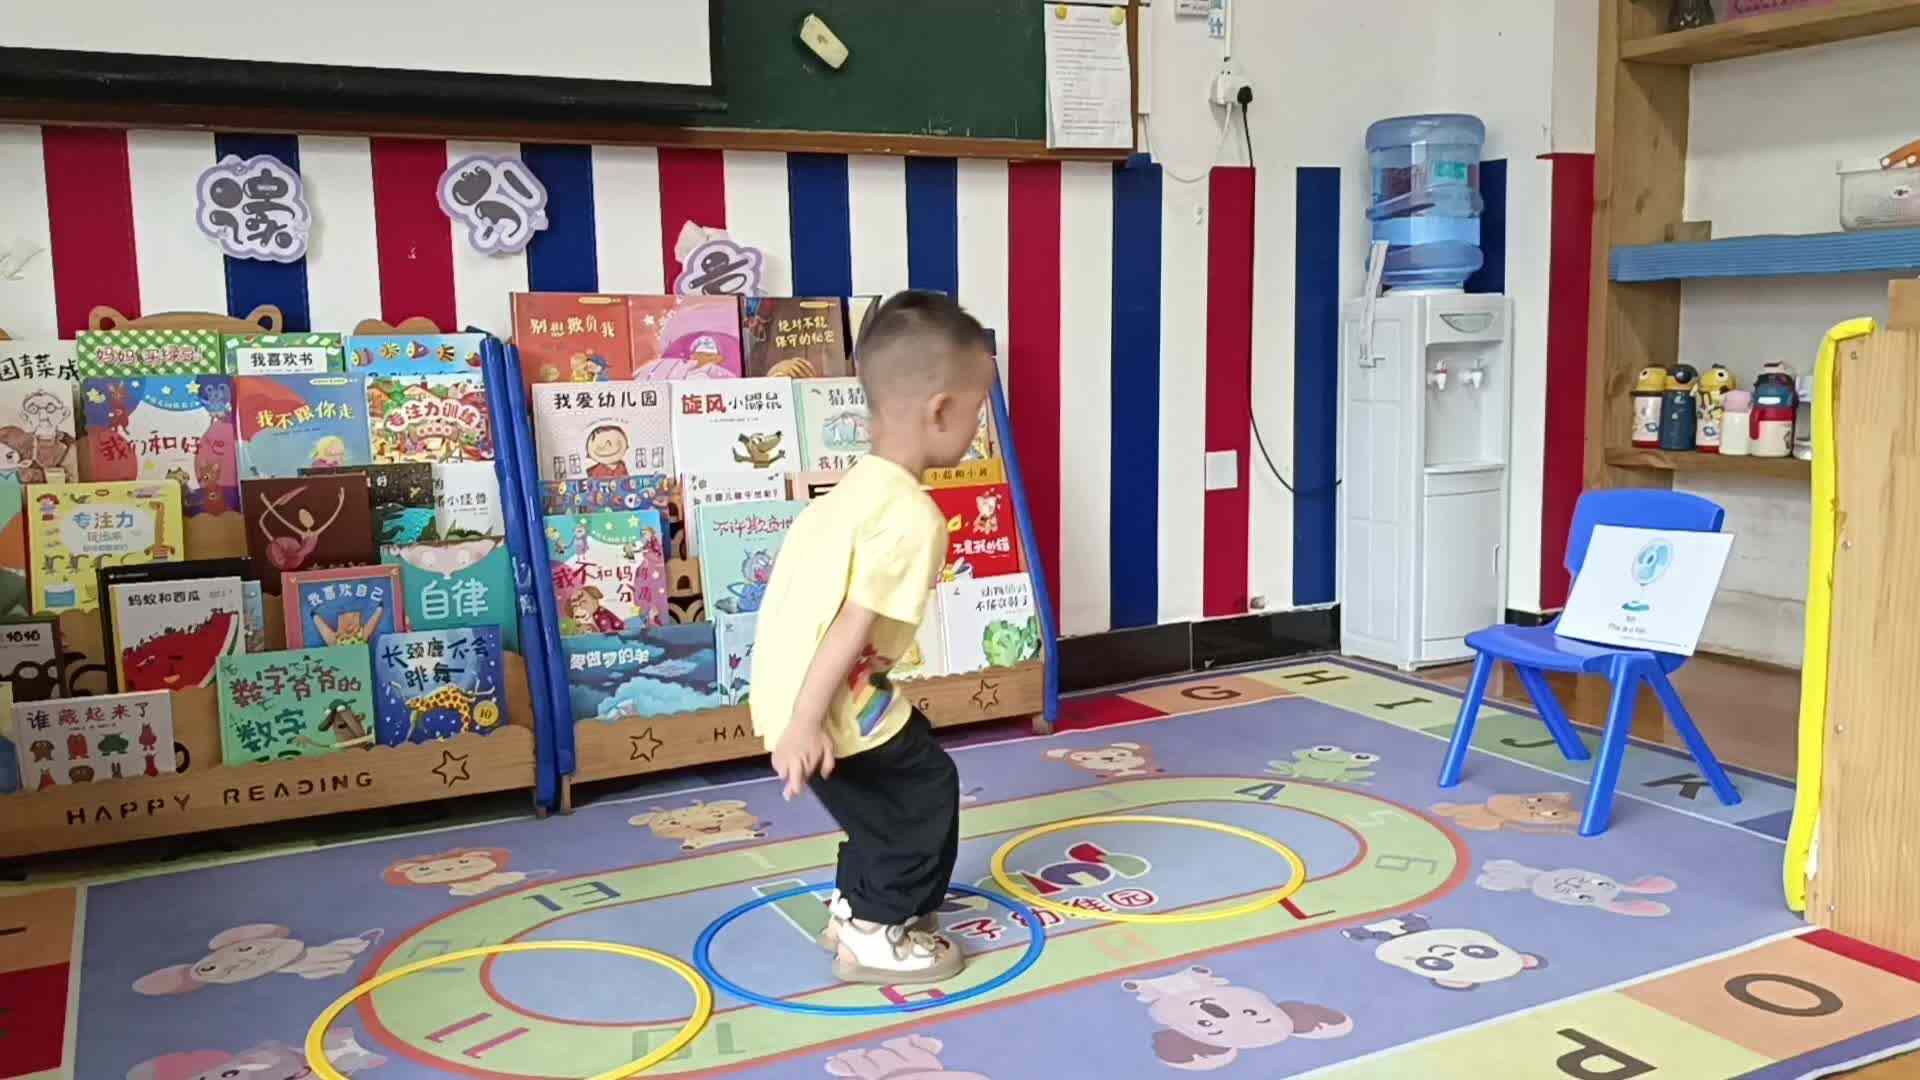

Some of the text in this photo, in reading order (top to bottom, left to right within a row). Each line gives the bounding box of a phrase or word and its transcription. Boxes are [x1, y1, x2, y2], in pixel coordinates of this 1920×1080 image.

[530, 314, 616, 337] 别想欺负我
[250, 351, 314, 367] 我喜欢书
[553, 390, 657, 409] 我爱幼儿园
[256, 401, 356, 429] 我不跟你走
[72, 510, 134, 529] 专注力
[128, 590, 200, 606] 蚂蚁和西瓜
[307, 583, 384, 606] 我喜欢自己
[421, 578, 489, 620] 自律
[382, 638, 490, 668] 长颈鹿不会
[405, 663, 464, 691] 跳舞
[1180, 685, 1242, 700] G
[26, 702, 150, 731] 谁藏起来了
[66, 771, 373, 824] HAPPY READING
[523, 881, 621, 912] 13
[1556, 1028, 1658, 1080] P
